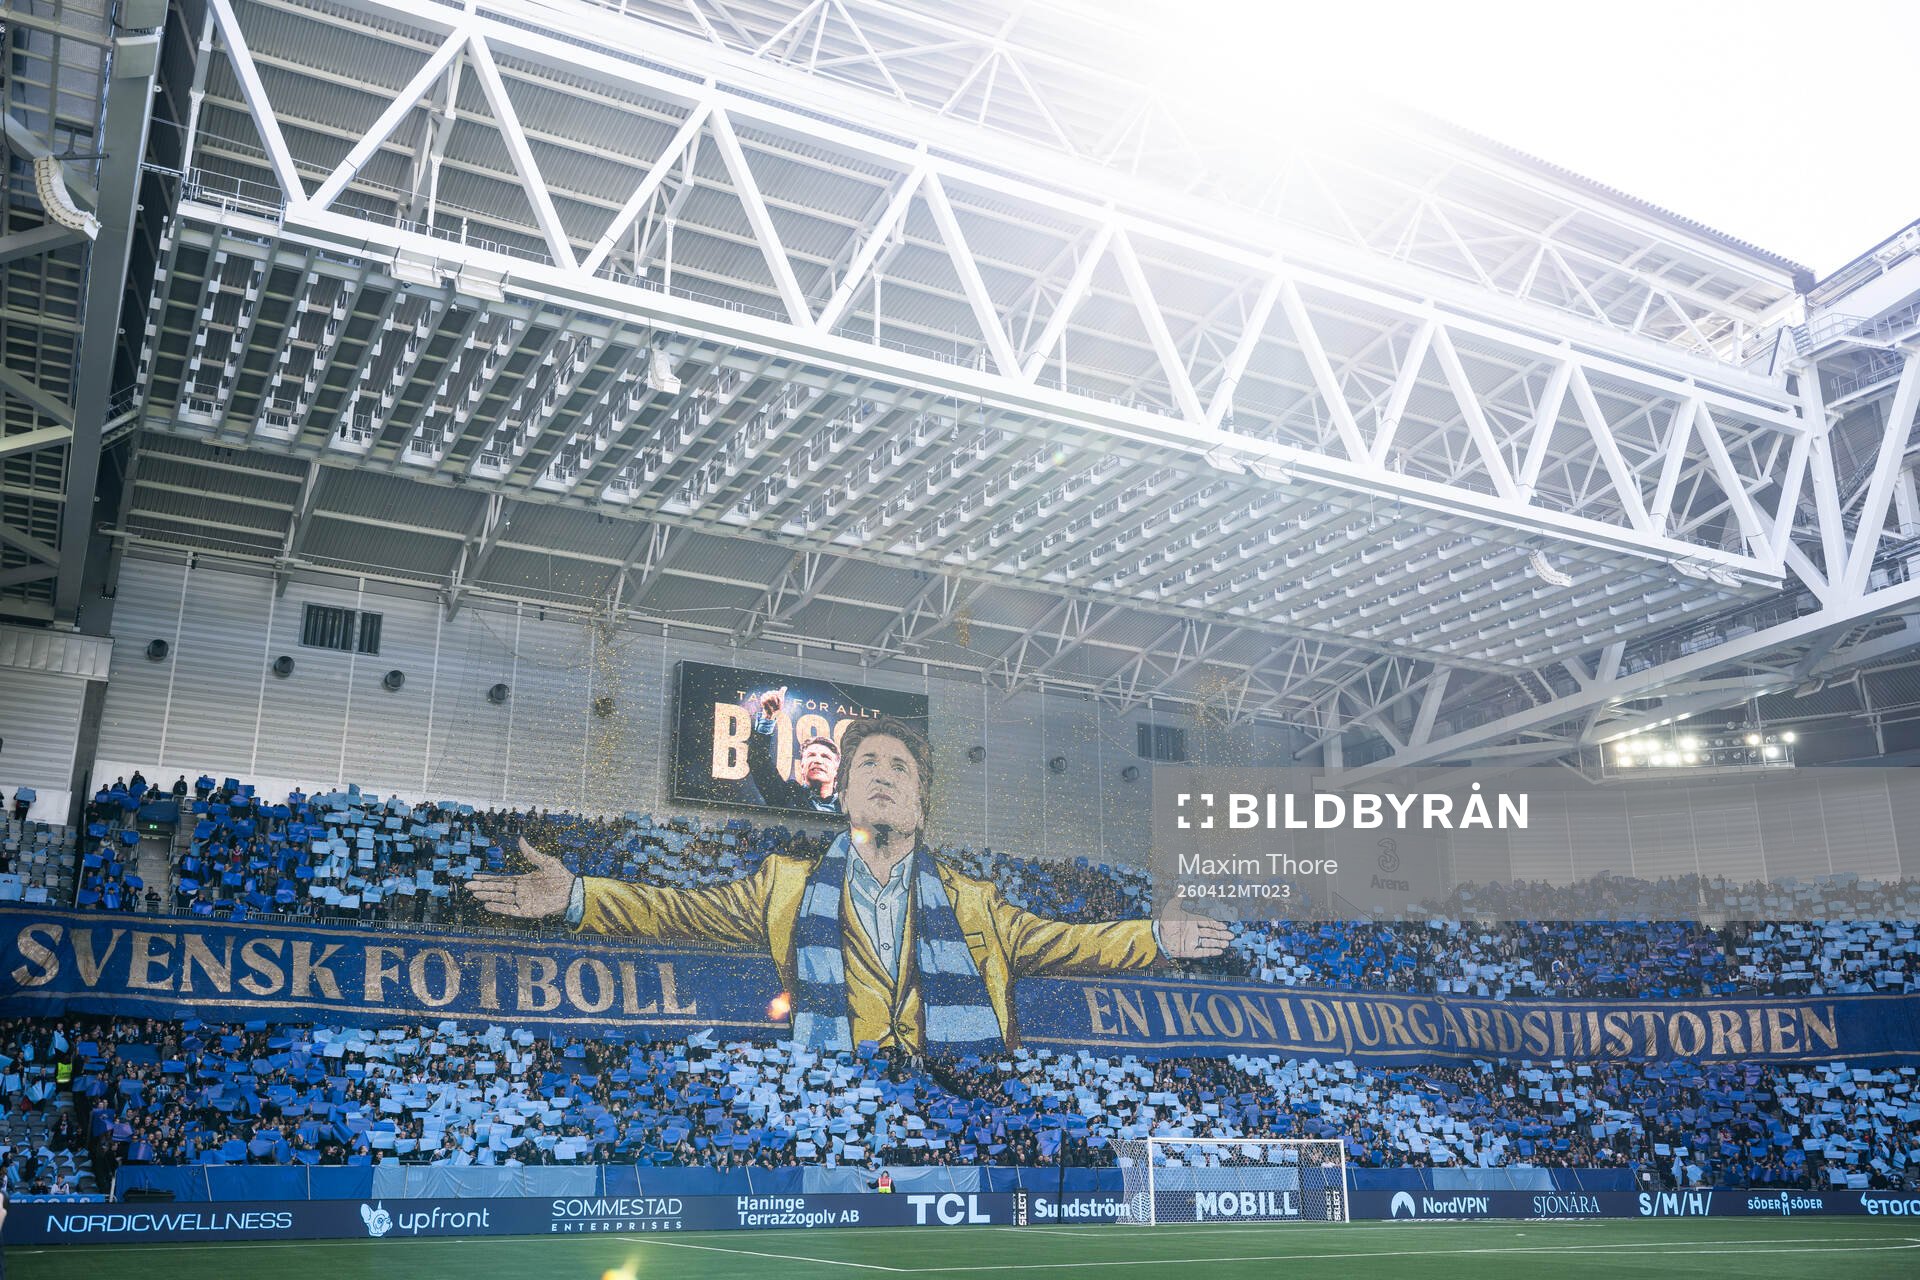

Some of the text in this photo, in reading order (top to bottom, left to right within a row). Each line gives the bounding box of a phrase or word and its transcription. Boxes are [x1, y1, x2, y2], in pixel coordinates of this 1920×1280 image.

[793, 696, 829, 712] FÖR
[836, 704, 880, 719] ALLT
[1370, 874, 1410, 892] Arena
[11, 922, 697, 1016] SVENSK FOTBOLL
[1083, 987, 1839, 1058] EN IKON I DJURGÅRDSHISTORIEN
[551, 1198, 682, 1217] SOMMESTAD
[737, 1196, 805, 1212] Haninge
[907, 1193, 991, 1225] TCL
[1018, 1192, 1027, 1226] SELECT
[1034, 1197, 1131, 1218] Sundström
[1195, 1191, 1298, 1221] MOBILL
[1333, 1190, 1341, 1221] SELECT
[1422, 1196, 1488, 1214] NordVPN
[1533, 1191, 1601, 1217] SJÖNÄRA
[1639, 1191, 1712, 1216] S/M/H/
[1747, 1197, 1781, 1210] SÖDER
[1790, 1197, 1823, 1210] SÖDER
[46, 1212, 292, 1233] NORDICWELLNESS
[398, 1206, 490, 1235] upfront
[551, 1221, 682, 1232] ENTERPRISES
[738, 1209, 860, 1228] Terrazzogolv AB
